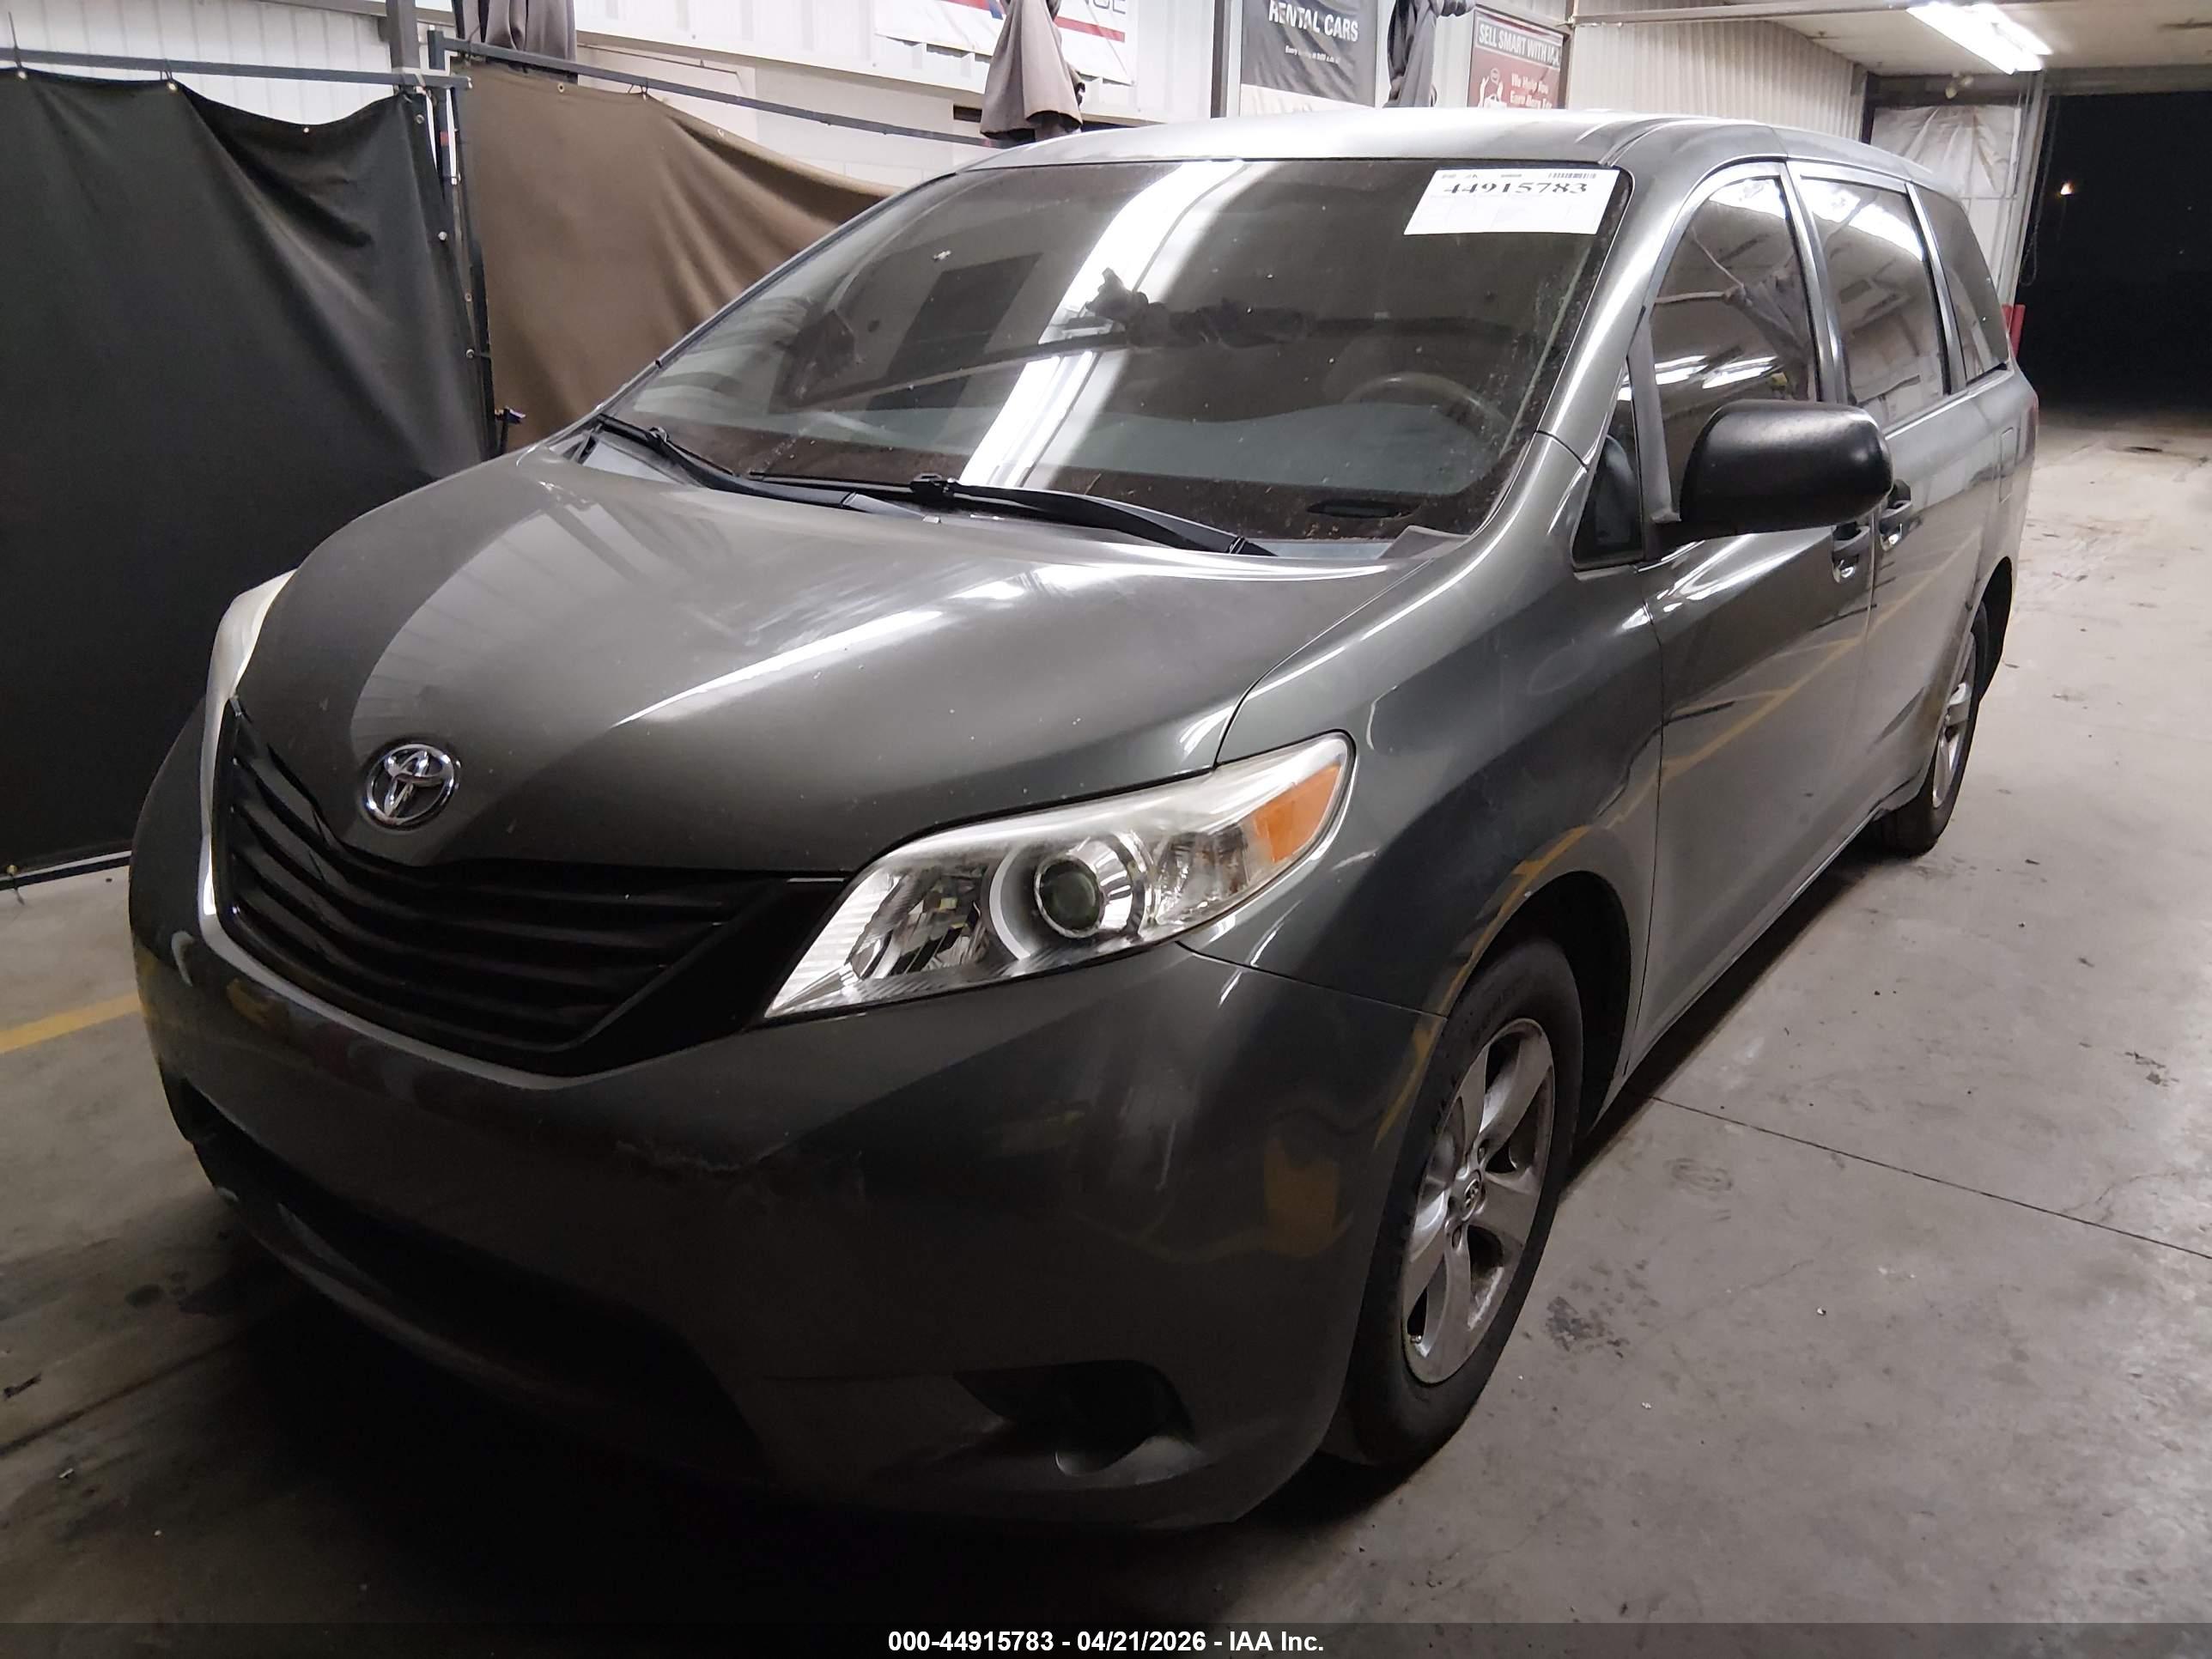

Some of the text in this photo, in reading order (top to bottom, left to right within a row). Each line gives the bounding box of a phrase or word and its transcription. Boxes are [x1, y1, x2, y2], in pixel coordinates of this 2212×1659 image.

[1268, 0, 1358, 42] RENTAL CARS
[1479, 23, 1497, 47] SELL
[1498, 30, 1526, 56] SMART
[1528, 38, 1547, 62] WITH
[1444, 183, 1588, 194] 44915783
